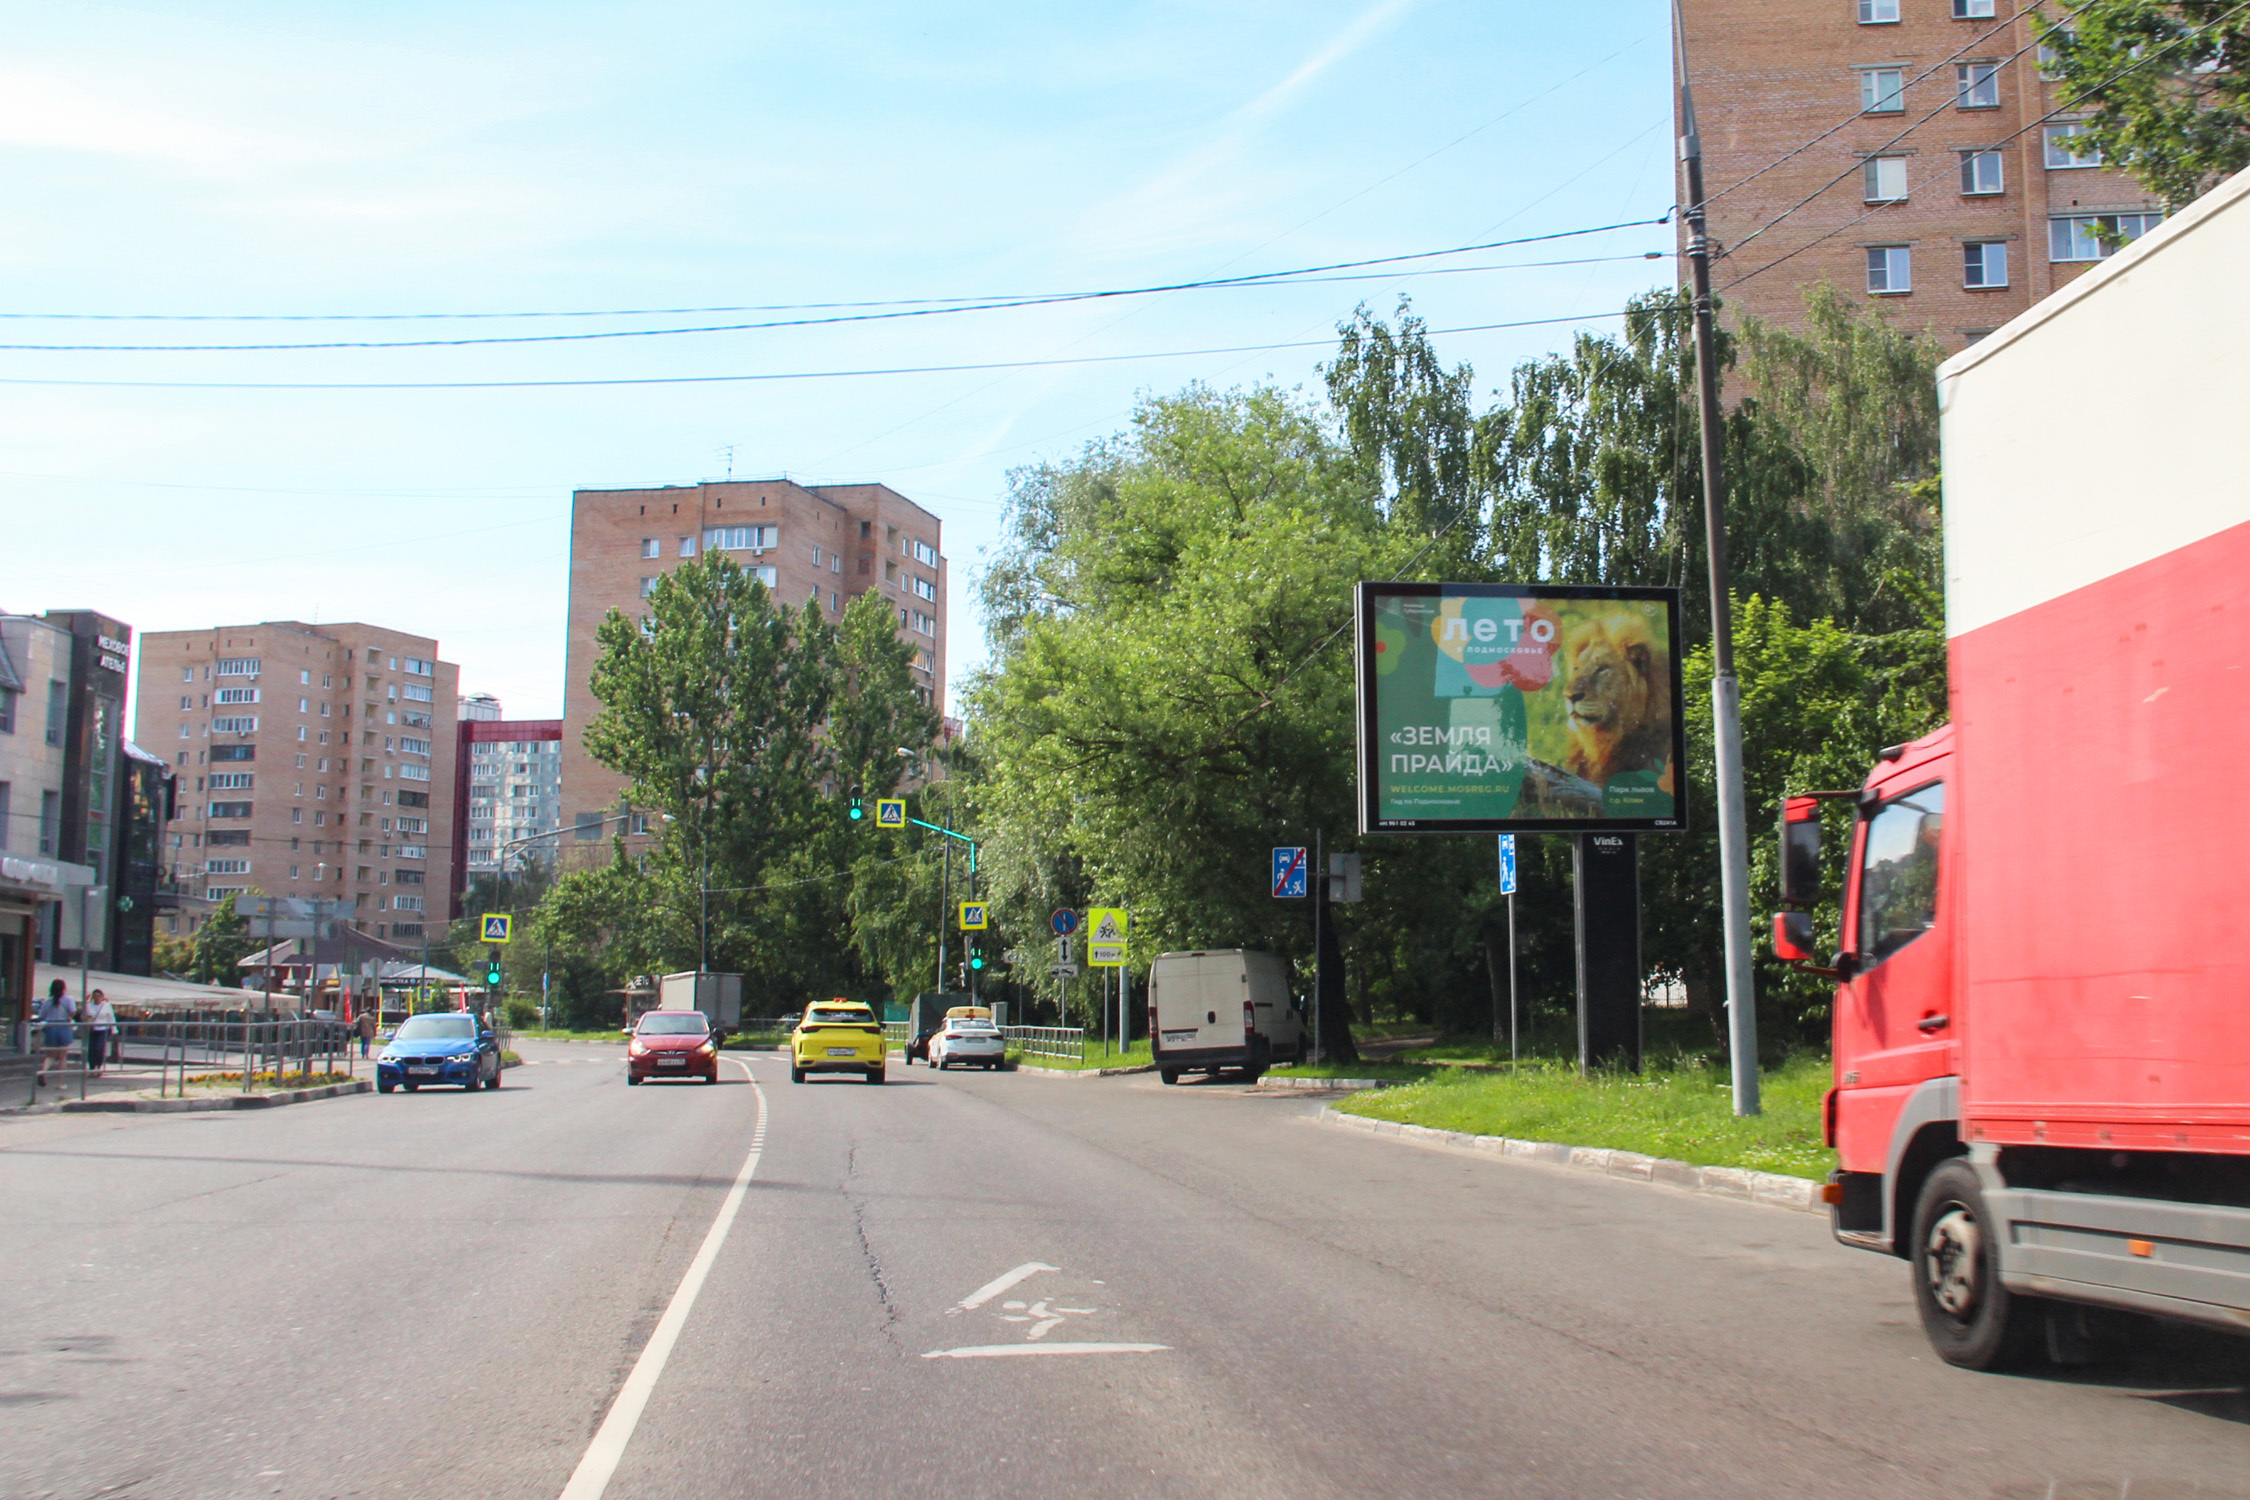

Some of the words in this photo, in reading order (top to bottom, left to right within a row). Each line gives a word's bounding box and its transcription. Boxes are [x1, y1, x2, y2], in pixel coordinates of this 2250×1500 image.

[1390, 726, 1491, 745] «ЗЕМЛЯ
[1391, 750, 1513, 777] ПРАЙДА»
[1390, 785, 1510, 793] WELCOME.MOSREG.RU
